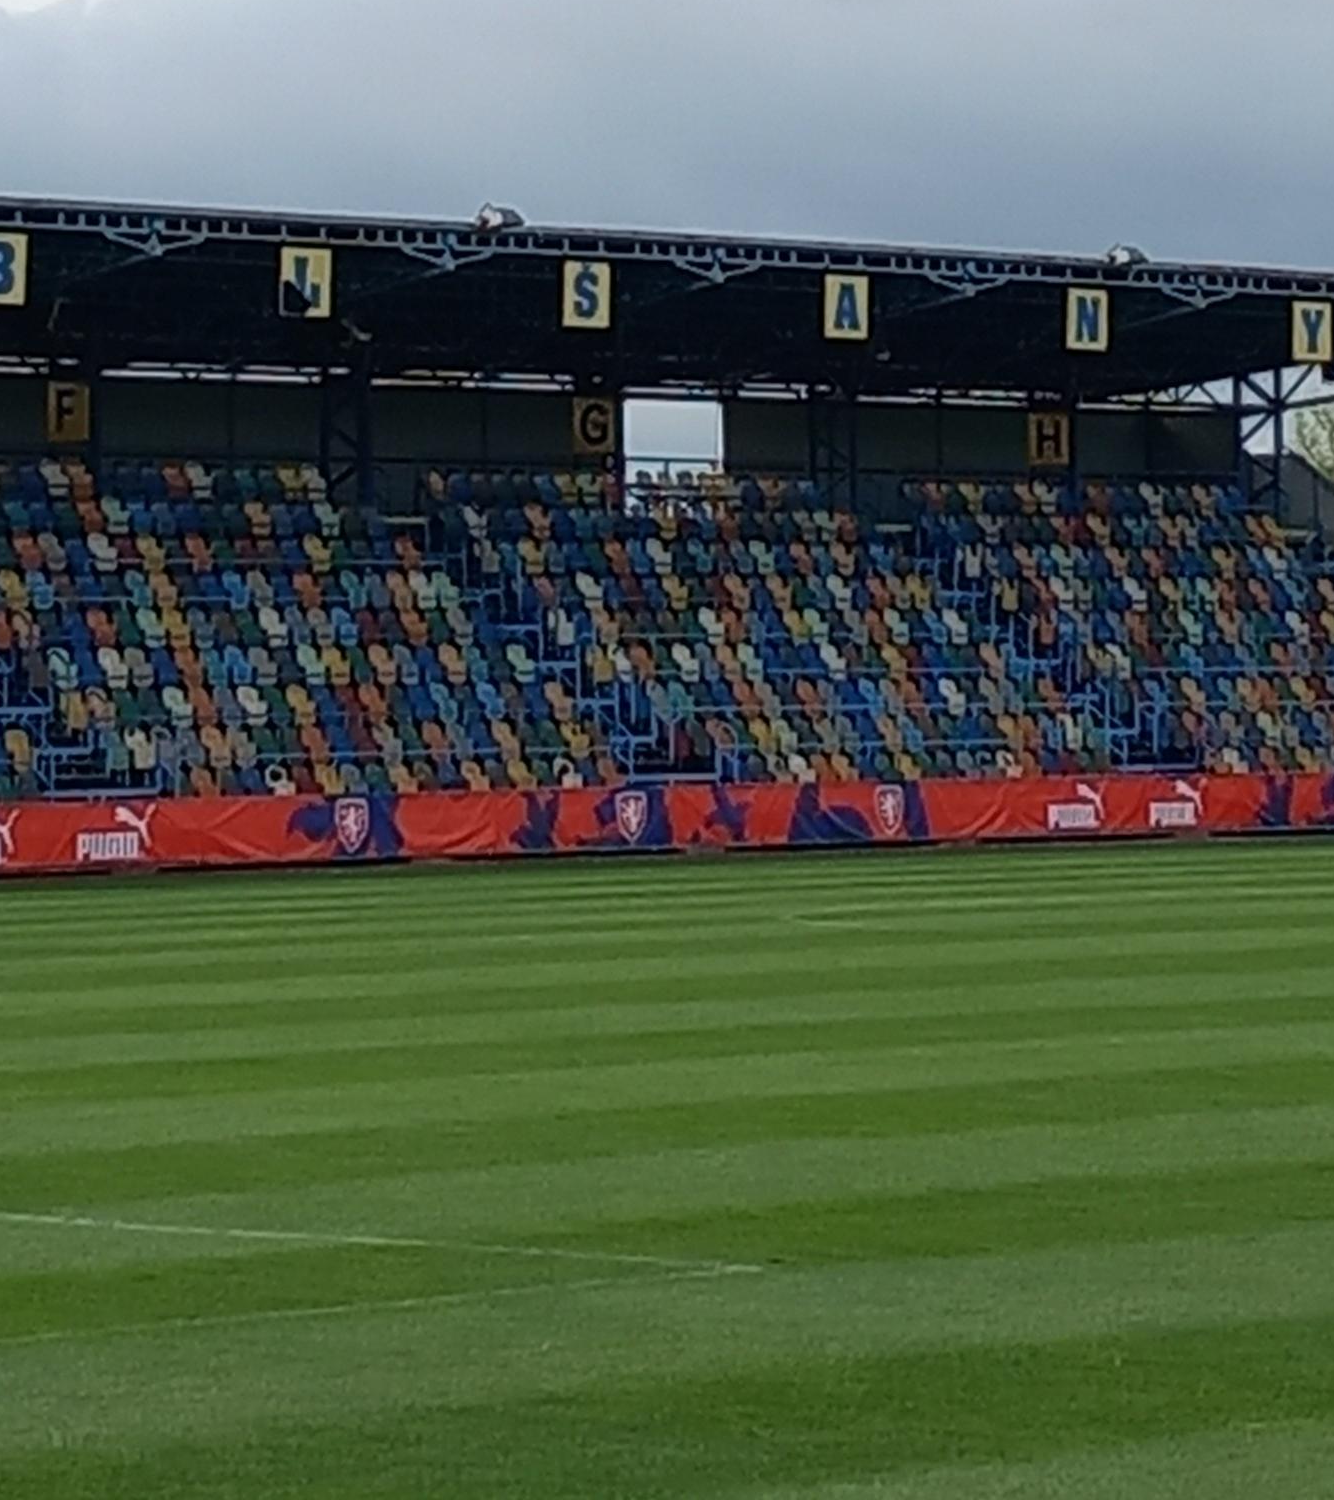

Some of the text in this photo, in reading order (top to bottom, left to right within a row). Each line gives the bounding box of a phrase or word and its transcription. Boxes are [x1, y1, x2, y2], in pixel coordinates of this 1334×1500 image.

[574, 262, 599, 318] Š
[834, 283, 861, 330] A
[1075, 296, 1100, 342] N
[1301, 309, 1325, 353] Y
[57, 389, 76, 432] F
[580, 403, 608, 445] G
[1036, 417, 1062, 458] H
